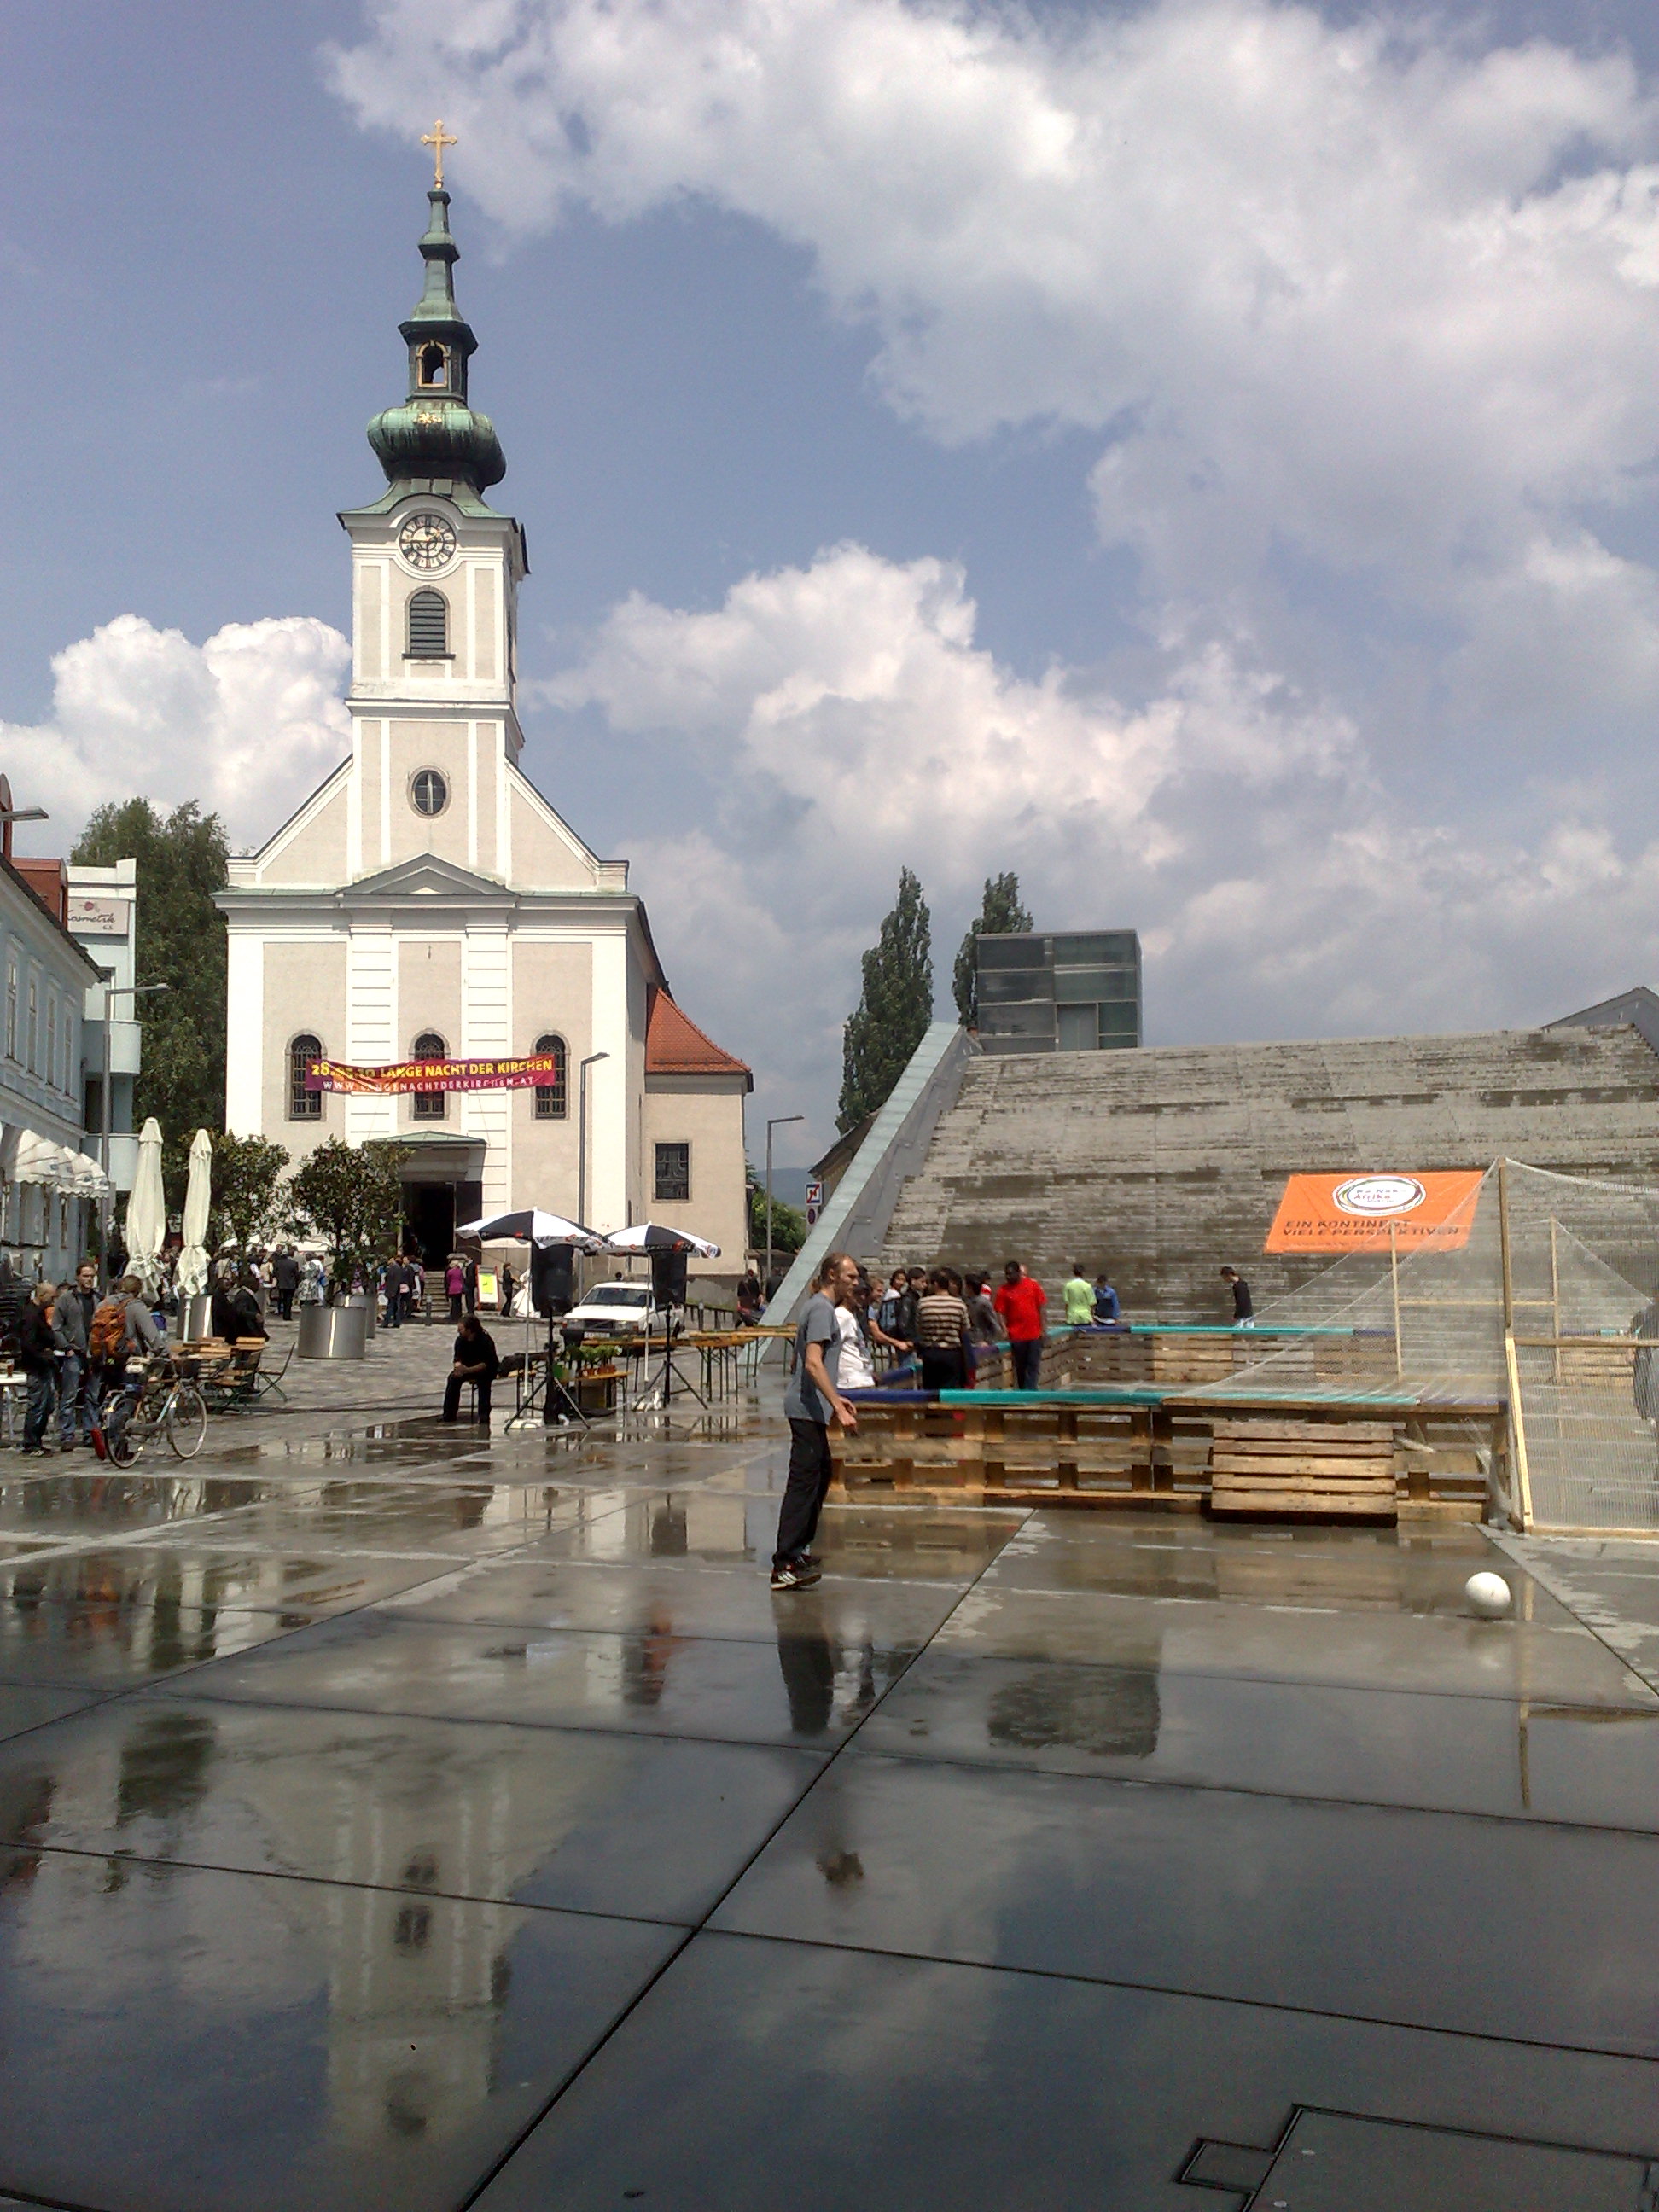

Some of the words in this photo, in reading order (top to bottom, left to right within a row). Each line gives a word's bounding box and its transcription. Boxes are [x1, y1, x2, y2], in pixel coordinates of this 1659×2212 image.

[381, 1065, 422, 1078] LANGE
[425, 1063, 467, 1077] NACHT
[469, 1063, 494, 1075] DER
[497, 1059, 553, 1074] KIRCHEN
[323, 1076, 533, 1092] WWW.NGENACHTDERKIRCHEN.AT
